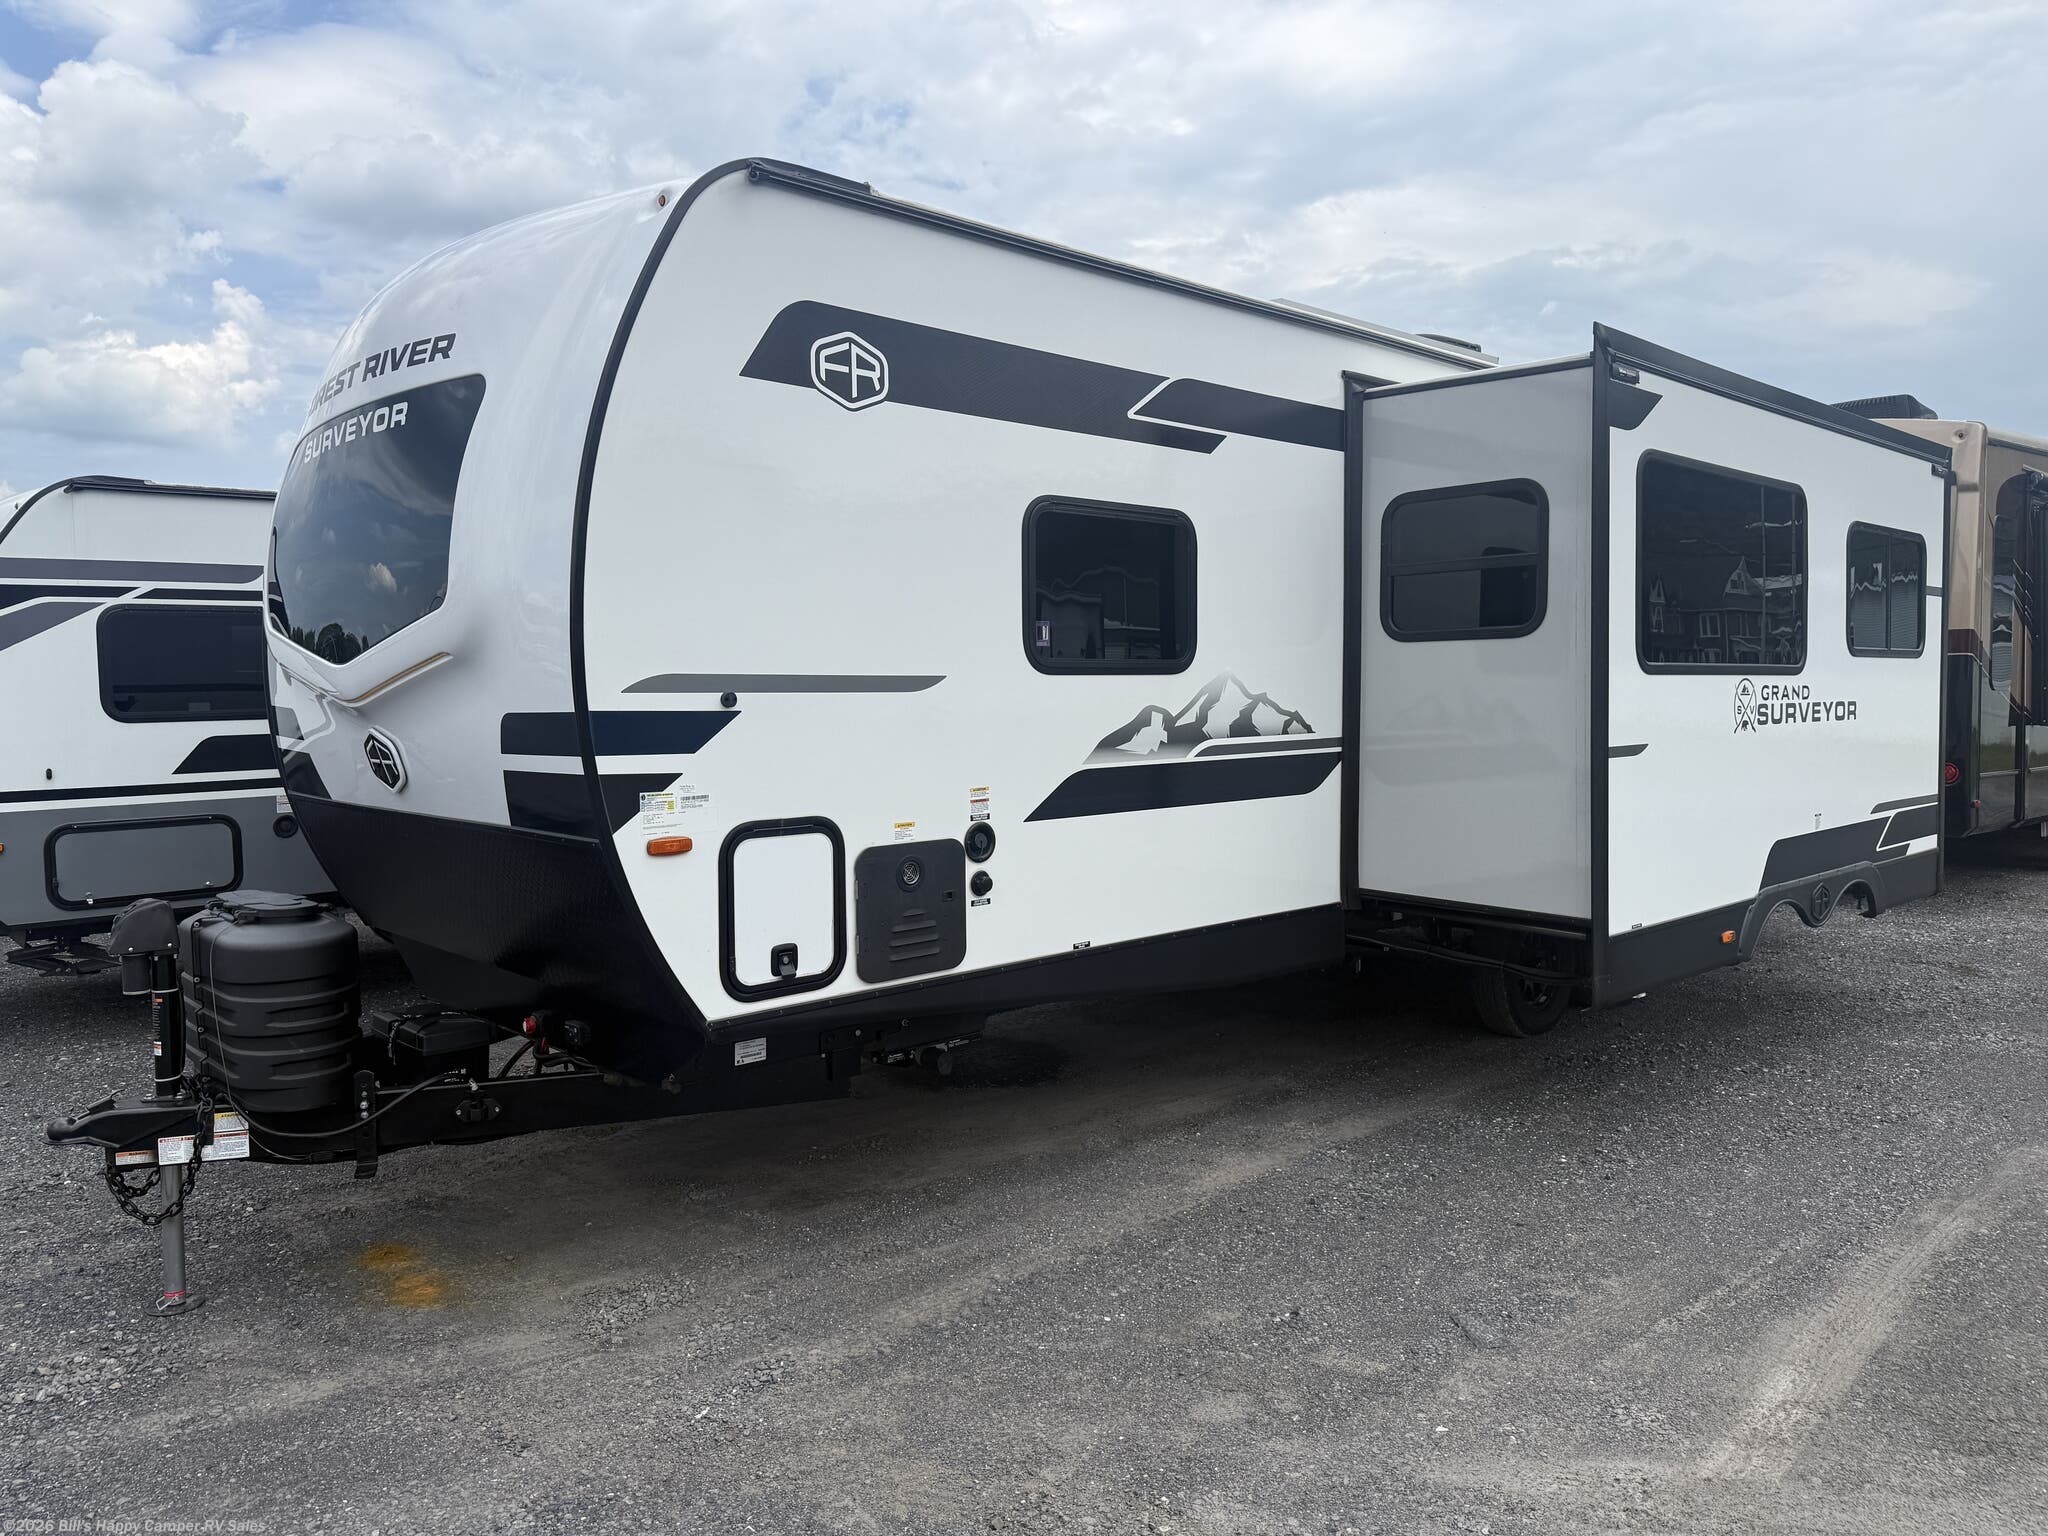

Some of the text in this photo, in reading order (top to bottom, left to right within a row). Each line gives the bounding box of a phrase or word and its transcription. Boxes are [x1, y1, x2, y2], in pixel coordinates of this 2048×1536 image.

[309, 333, 457, 417] OREST RIVER
[304, 401, 408, 463] SURVEYOR
[1761, 684, 1810, 701] GRAND
[1737, 705, 1742, 715] S
[1757, 701, 1857, 725] SURVEYOR
